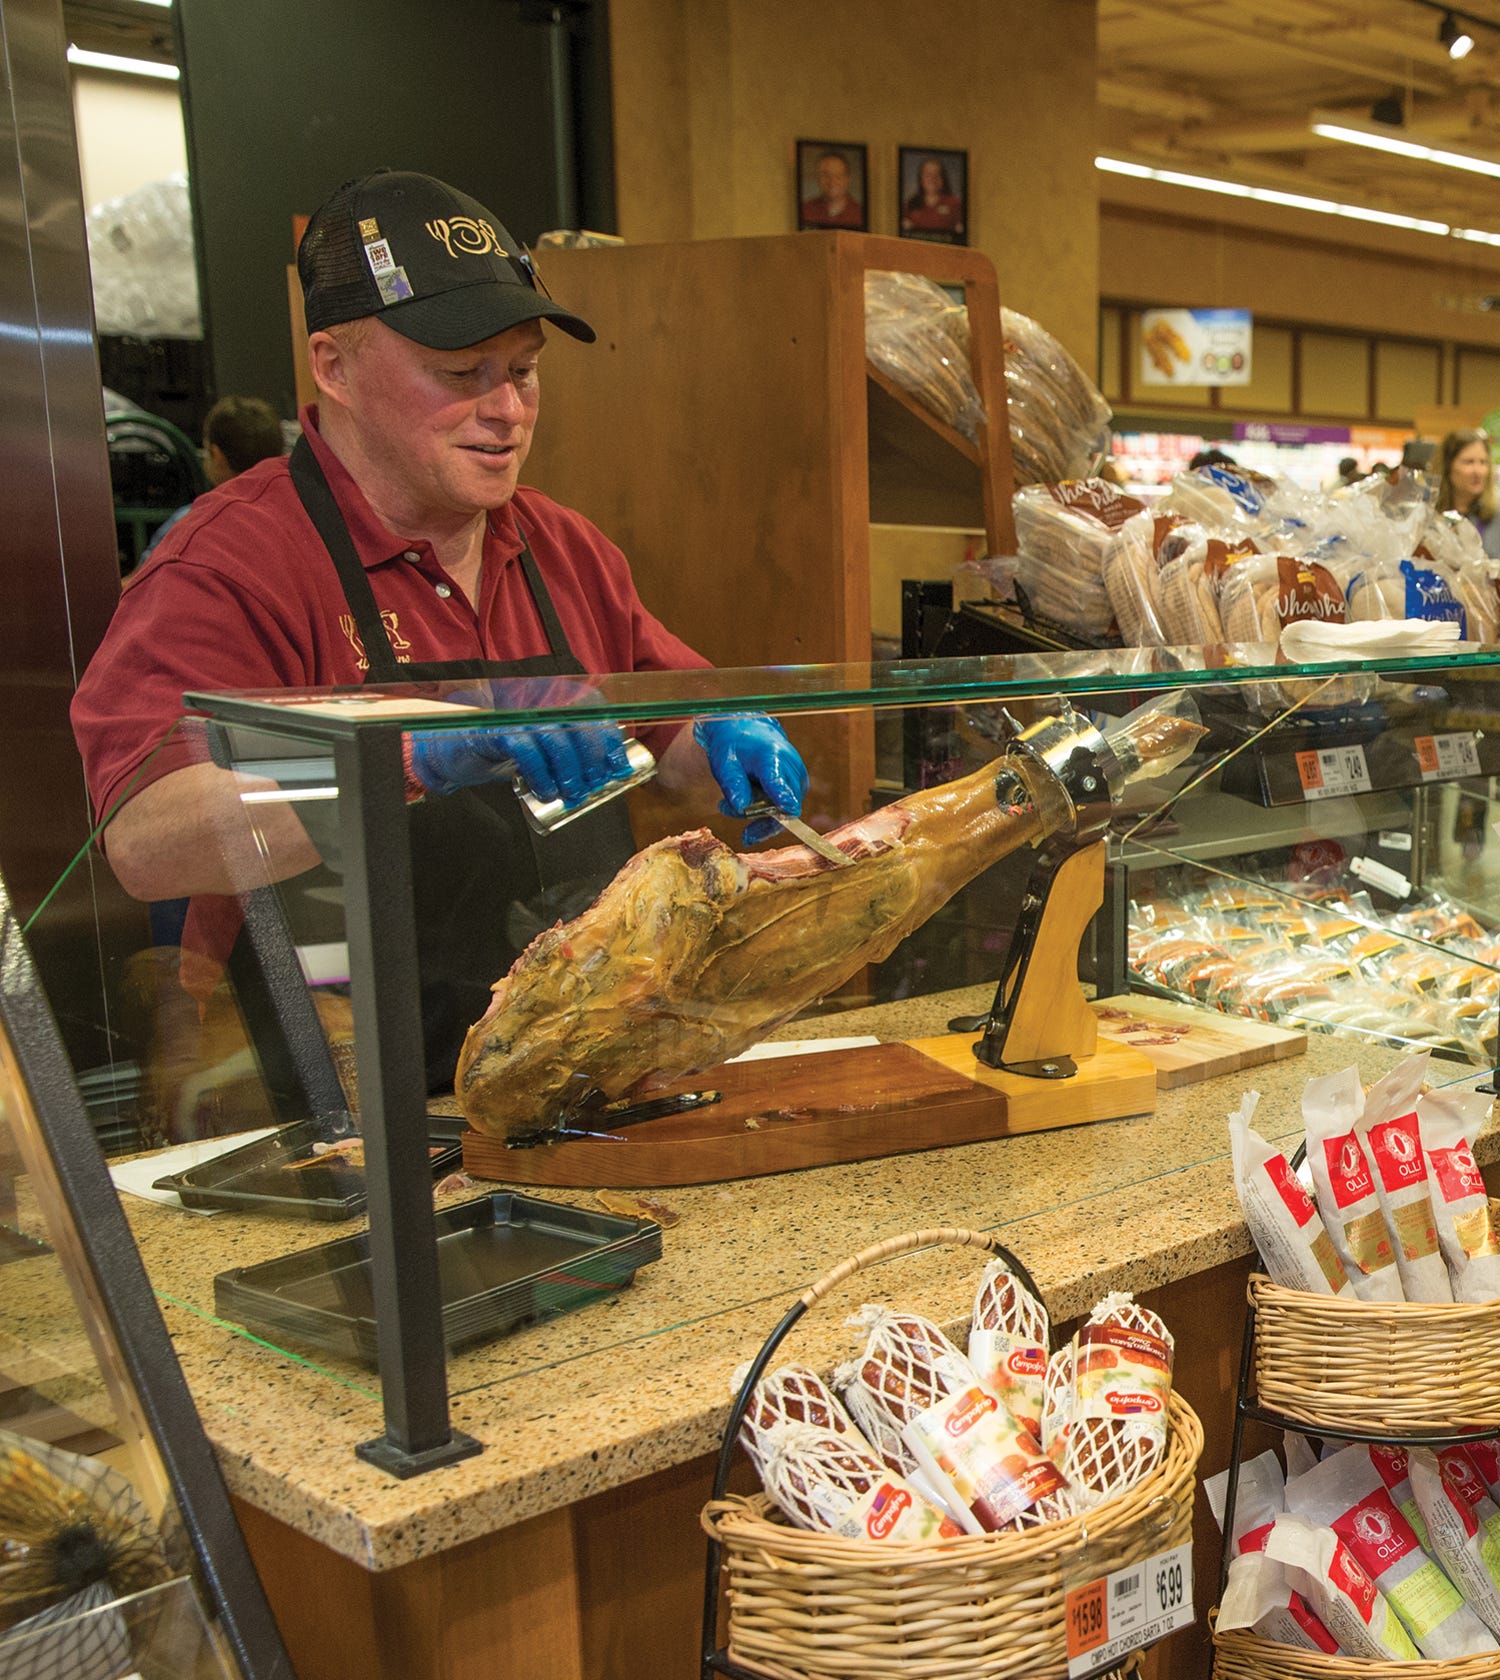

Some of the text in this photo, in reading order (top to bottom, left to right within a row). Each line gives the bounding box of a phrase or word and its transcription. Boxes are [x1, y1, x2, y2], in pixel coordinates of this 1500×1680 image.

[1399, 1159, 1422, 1177] OLLI
[1345, 1172, 1369, 1192] OLLI
[1109, 1395, 1159, 1409] Campofrio
[1377, 1535, 1405, 1559] OLLI
[1156, 1563, 1182, 1610] $6.99
[1072, 1597, 1102, 1638] $15.98
[1107, 1642, 1118, 1656] HOT
